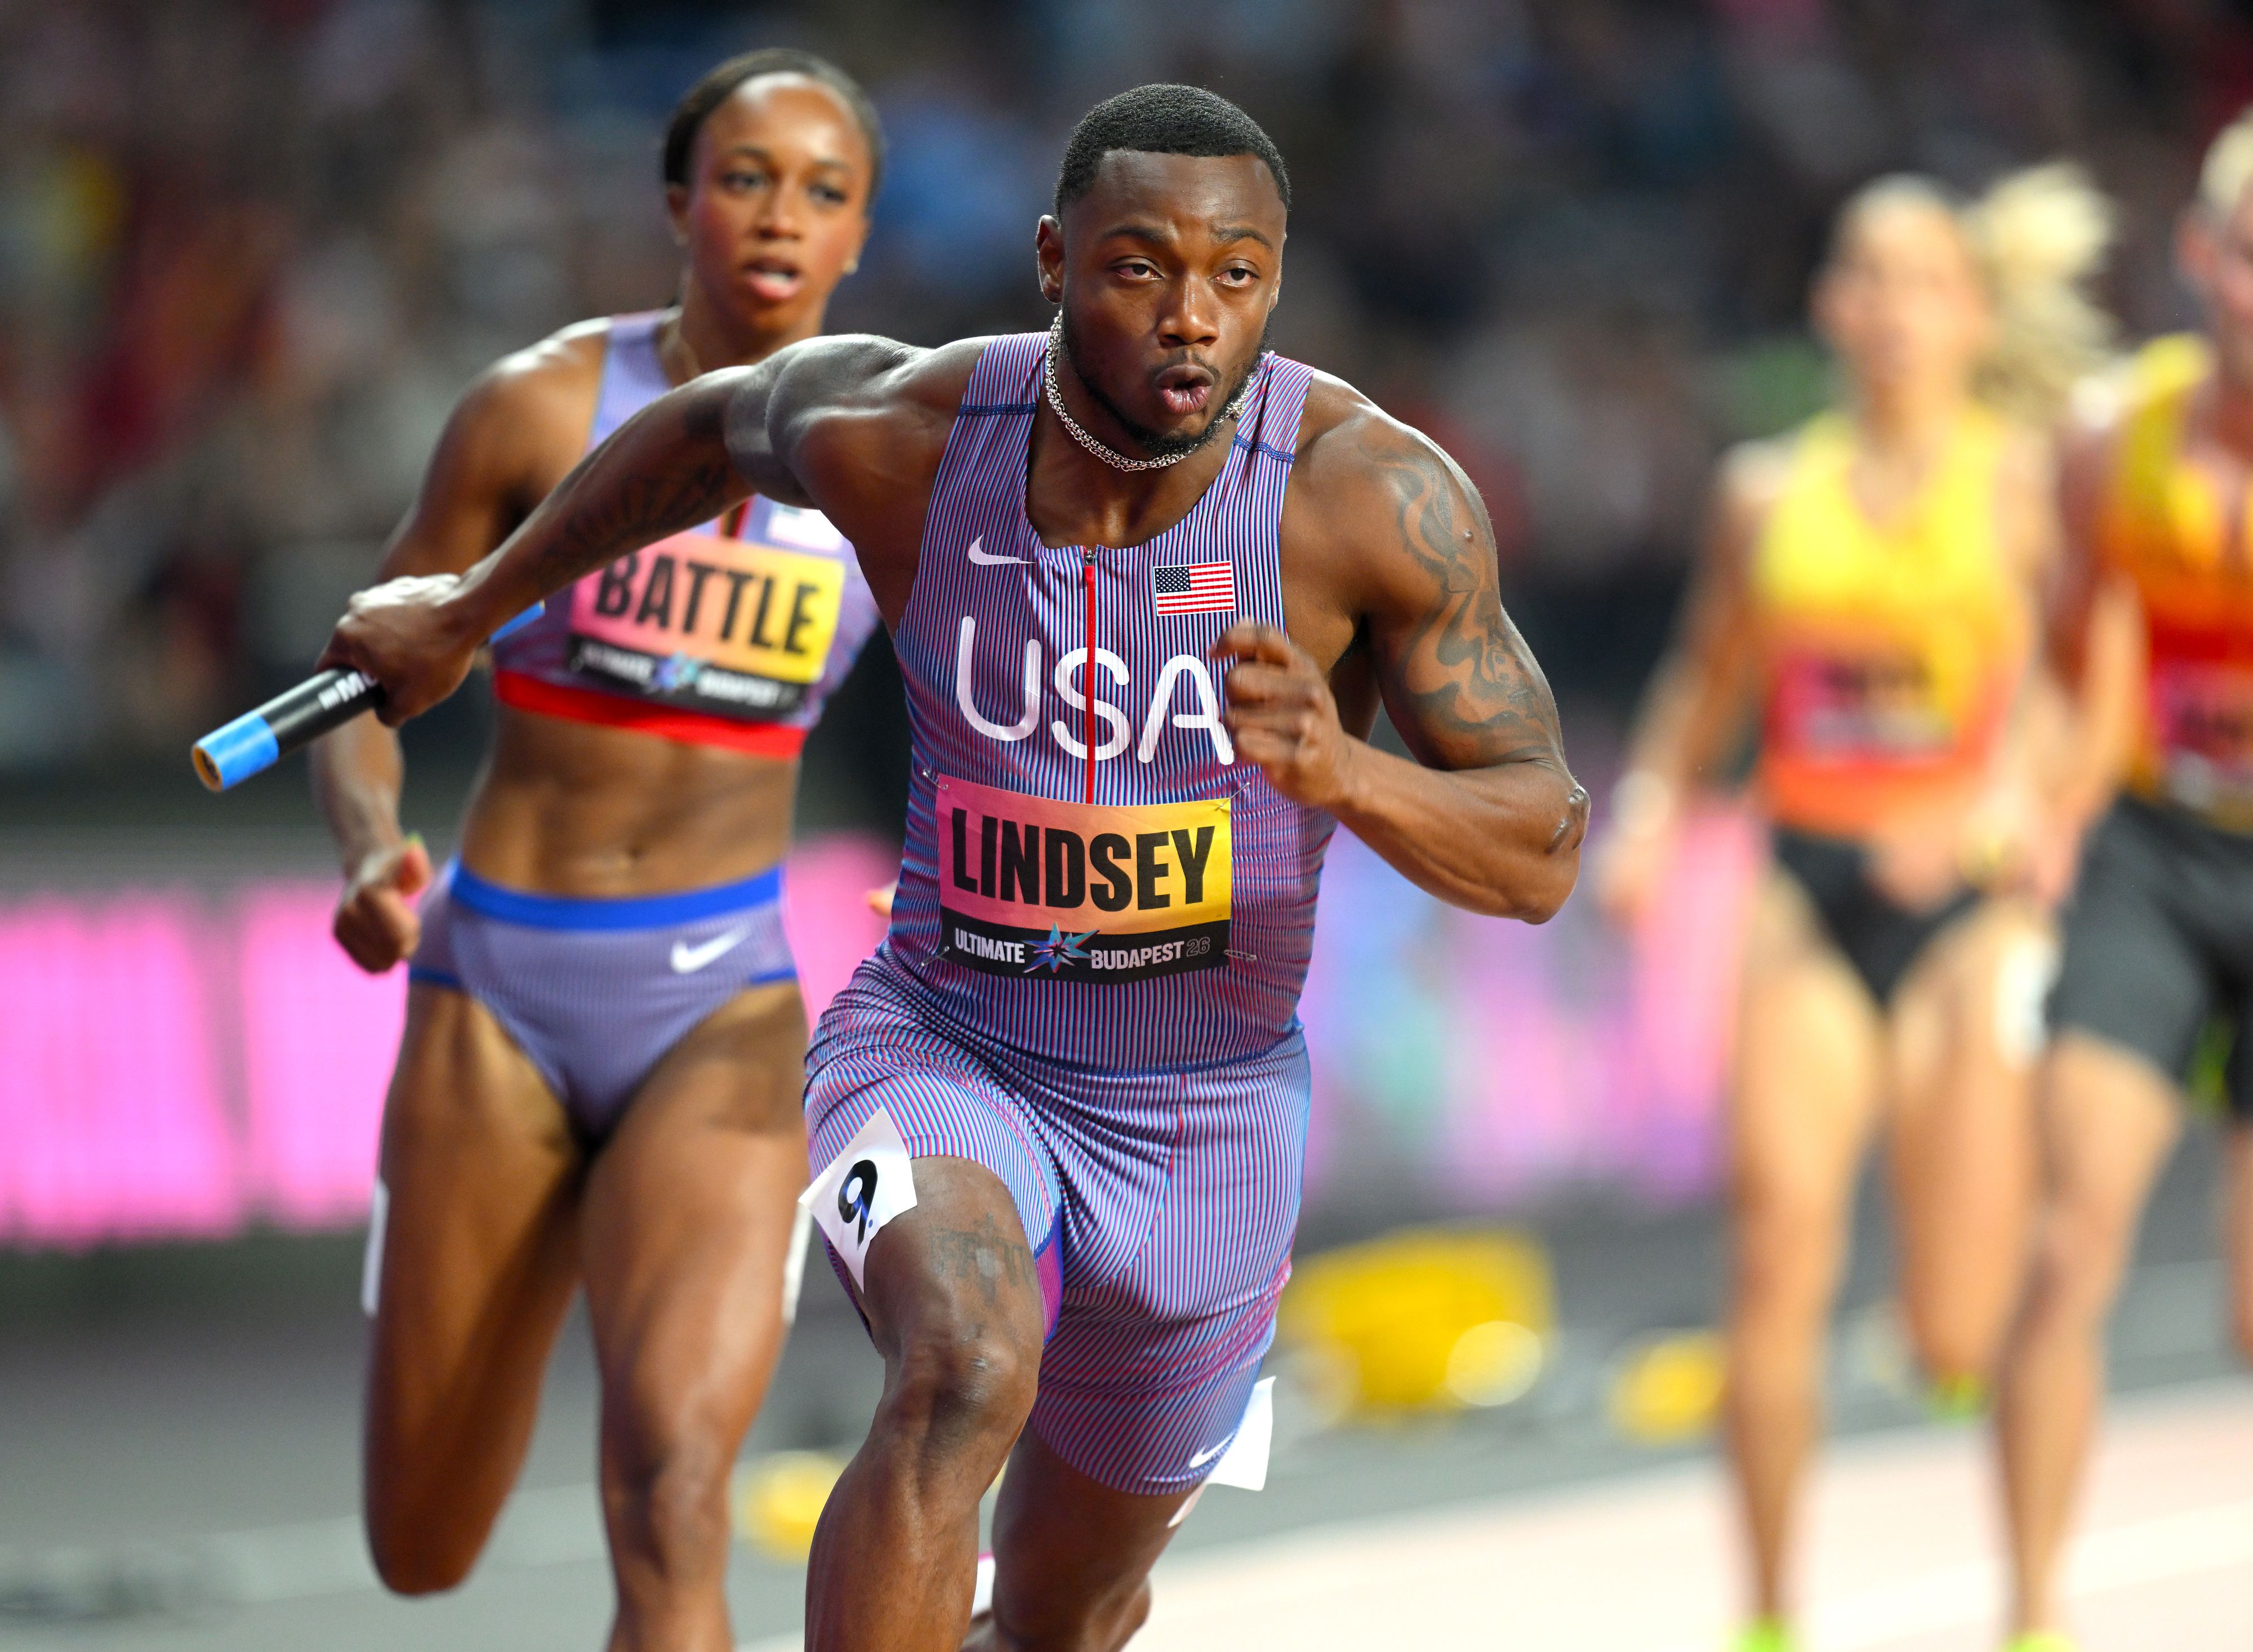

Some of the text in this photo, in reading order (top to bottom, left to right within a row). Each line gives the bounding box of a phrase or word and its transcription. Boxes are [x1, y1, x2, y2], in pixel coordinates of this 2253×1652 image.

[595, 550, 821, 656] BATTLE
[957, 616, 1235, 765] USA
[951, 807, 1215, 912] LINDSEY
[955, 927, 1211, 970] ULTIMATE BUDAPEST 26
